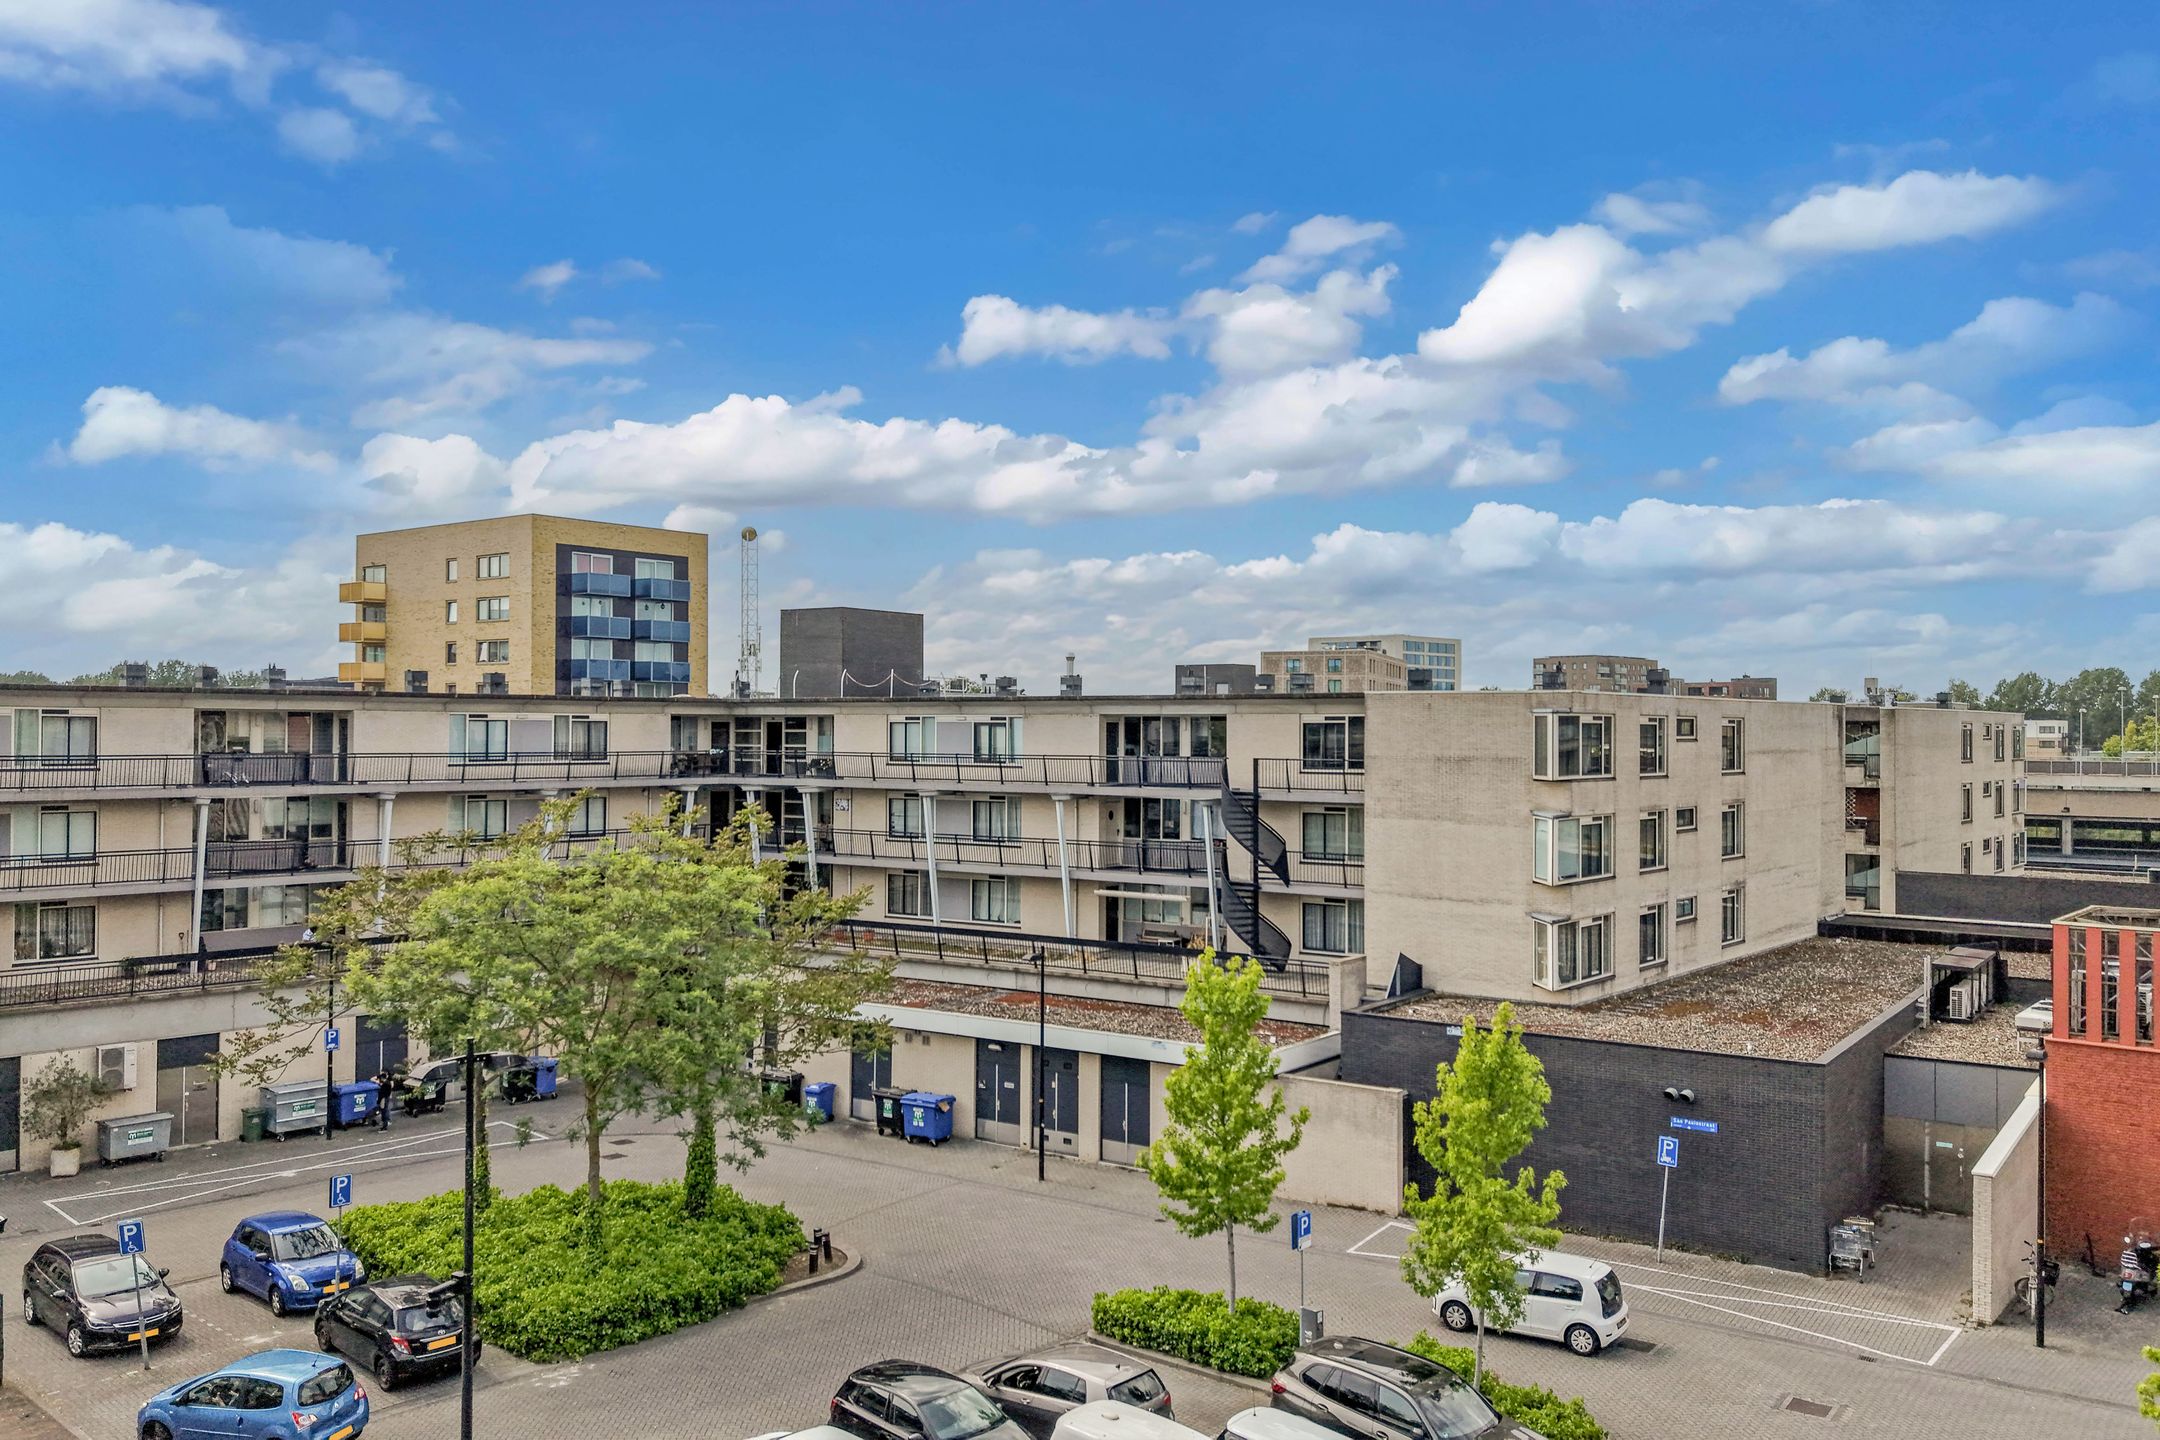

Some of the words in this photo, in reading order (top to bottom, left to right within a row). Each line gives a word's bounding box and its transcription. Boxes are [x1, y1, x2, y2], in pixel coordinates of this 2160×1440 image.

[328, 1031, 336, 1042] P
[1663, 1139, 1674, 1153] P
[336, 1177, 348, 1193] P
[123, 1225, 137, 1242] P
[1301, 1216, 1309, 1235] P
